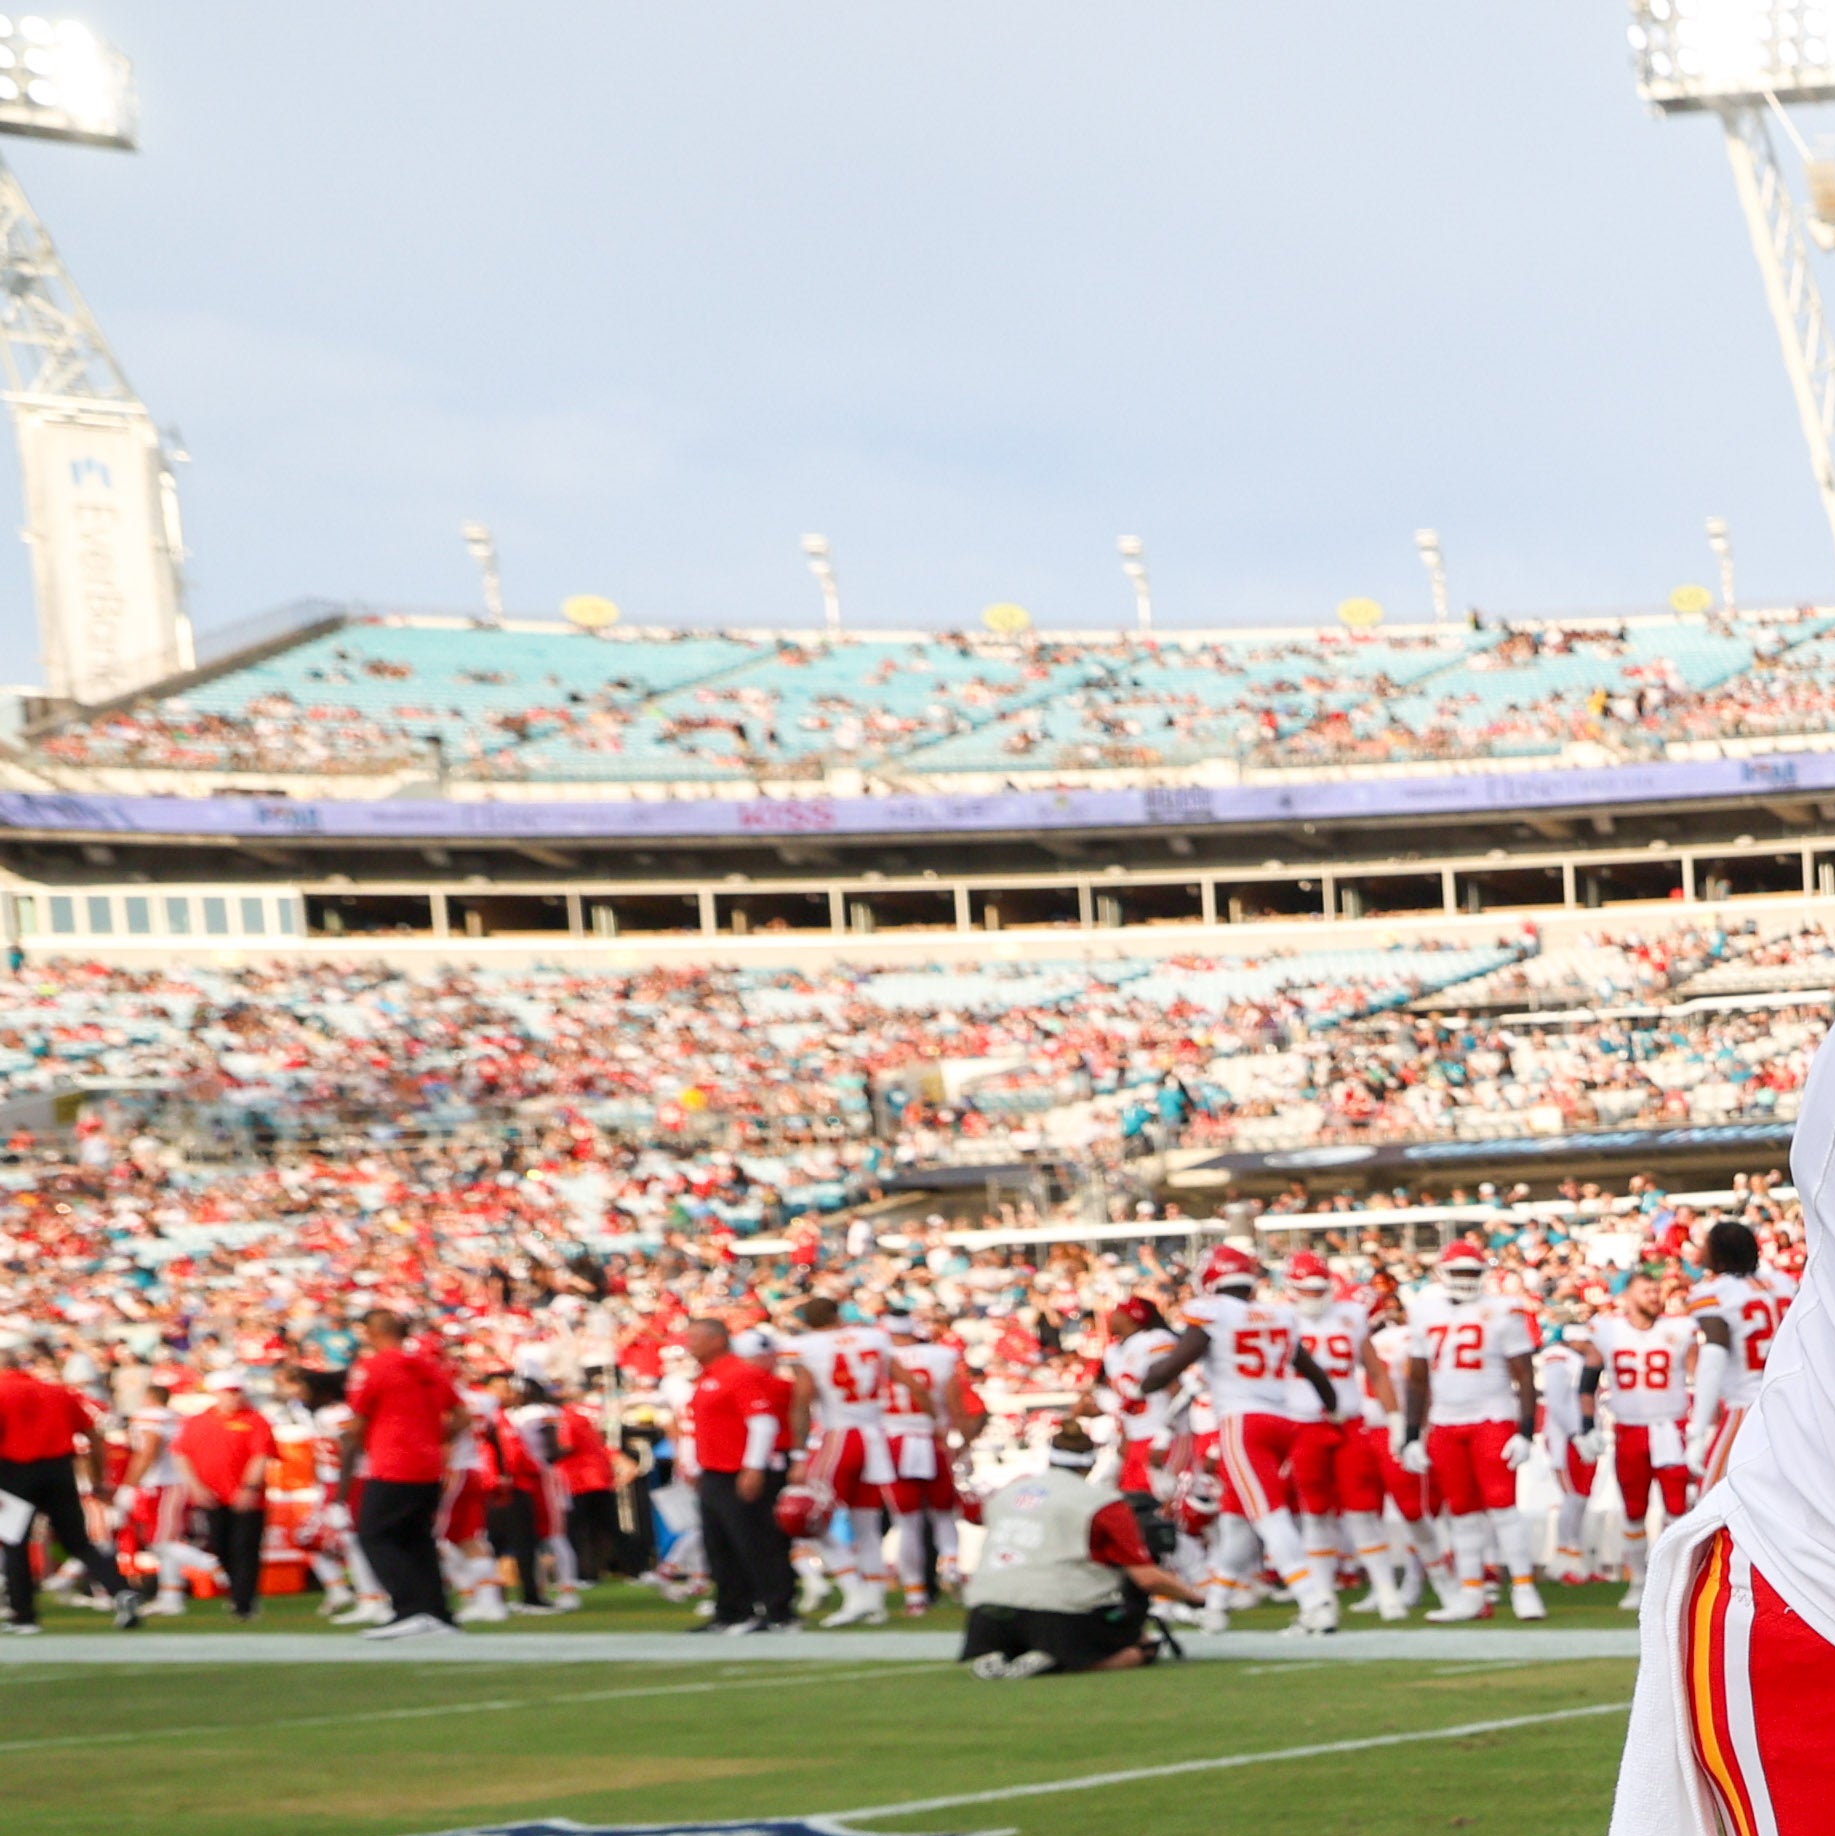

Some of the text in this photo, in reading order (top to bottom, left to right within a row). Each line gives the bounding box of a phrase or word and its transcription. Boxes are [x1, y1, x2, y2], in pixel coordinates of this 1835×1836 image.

[1234, 1328, 1290, 1379] 57
[1427, 1324, 1484, 1370] 72
[1613, 1349, 1670, 1390] 68
[831, 1349, 883, 1402] 47
